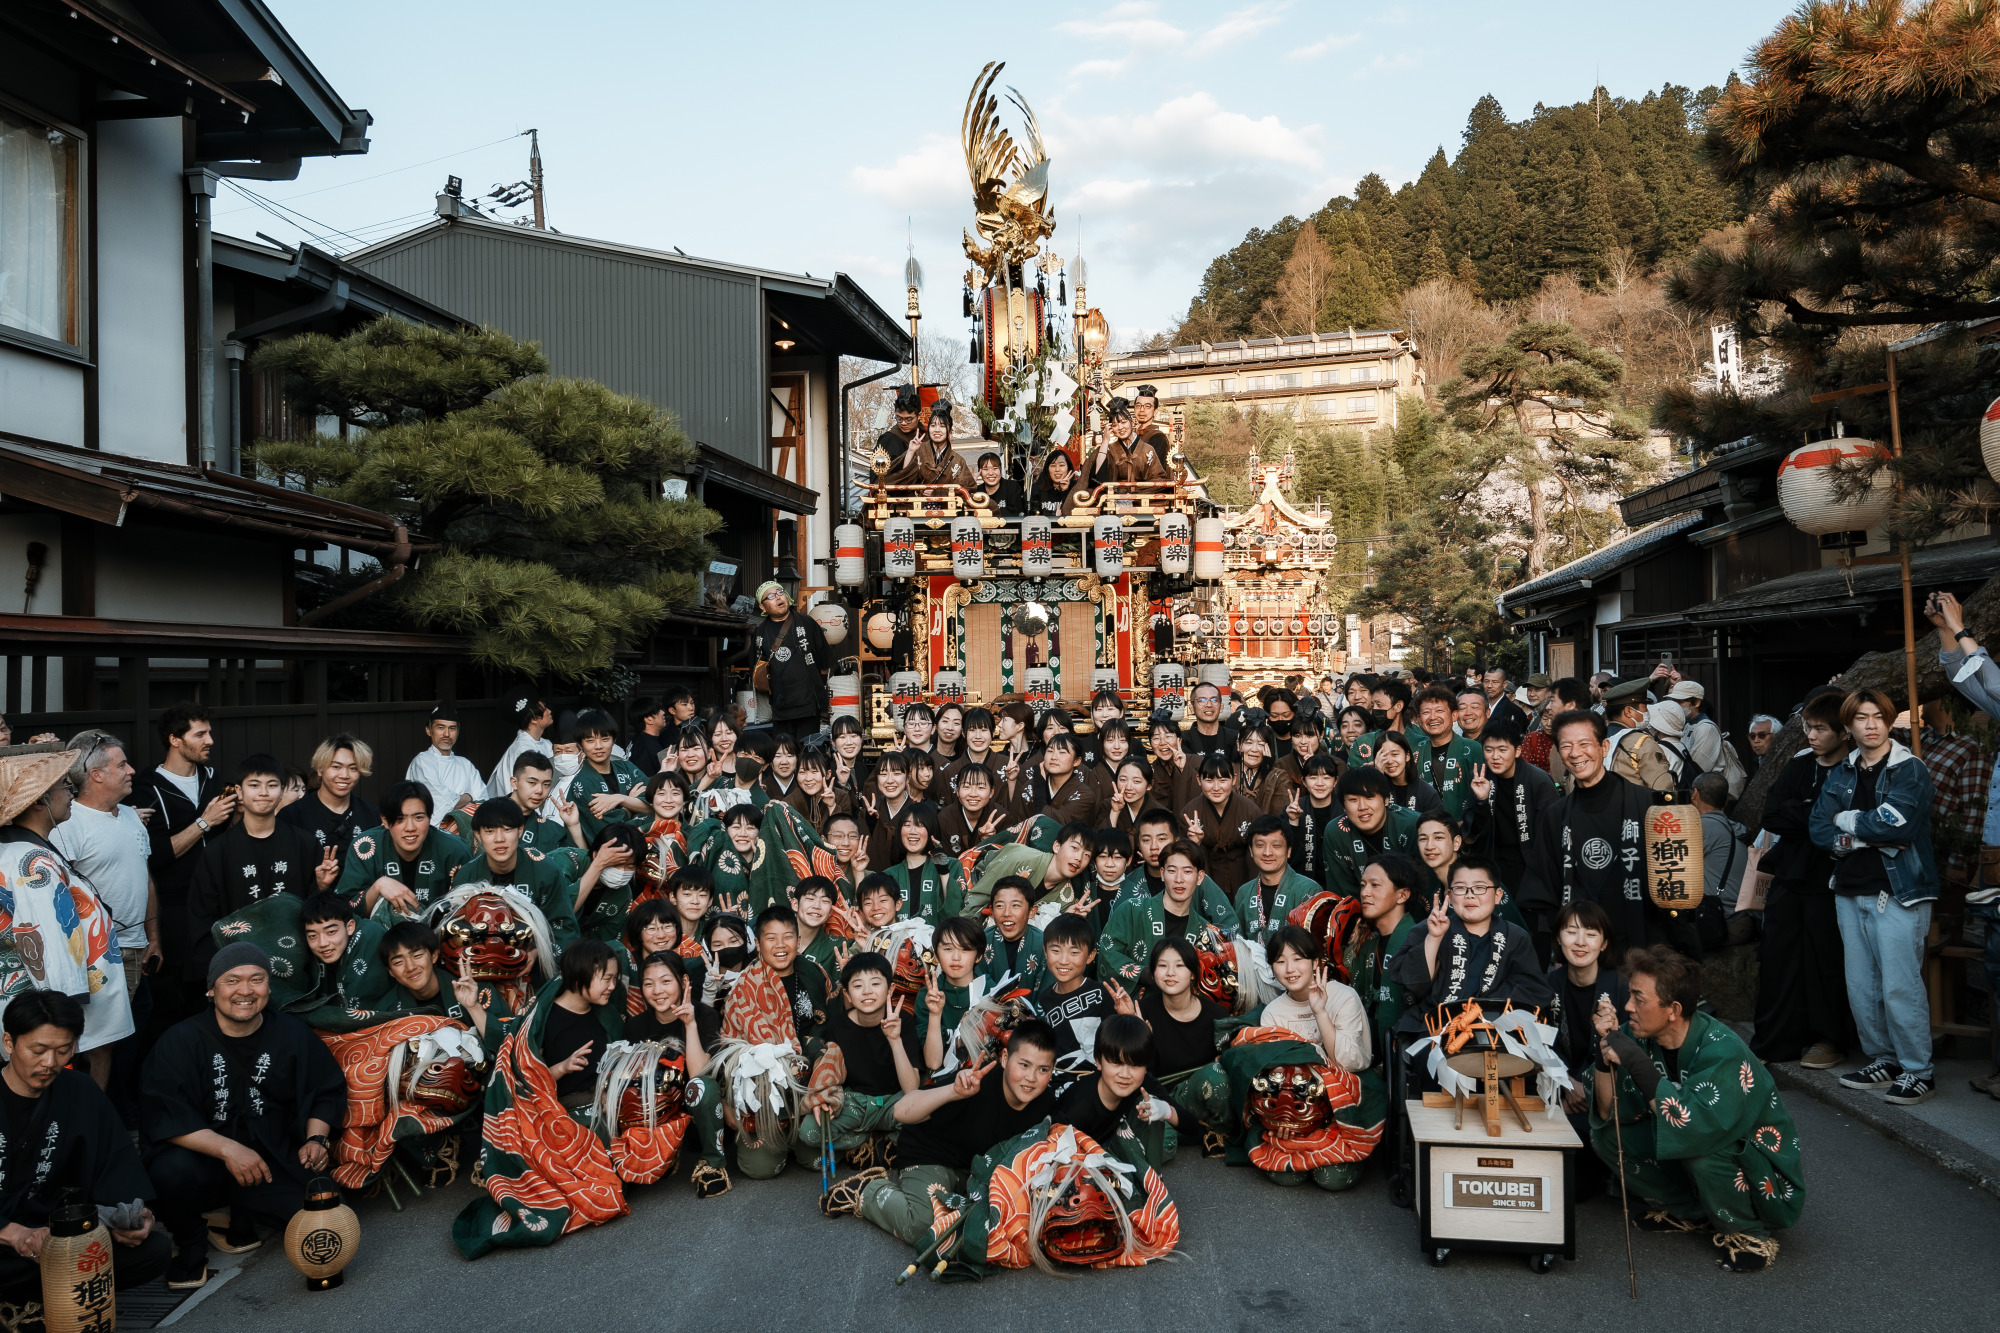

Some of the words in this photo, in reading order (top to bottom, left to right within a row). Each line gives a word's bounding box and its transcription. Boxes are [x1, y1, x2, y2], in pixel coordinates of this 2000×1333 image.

[1621, 818, 1642, 901] 獅子組
[1651, 837, 1690, 901] 獅子組
[242, 864, 261, 899] 獅子
[1458, 1180, 1535, 1197] TOKUBEI
[1492, 1199, 1517, 1207] SINCE
[1518, 1200, 1536, 1208] 1876
